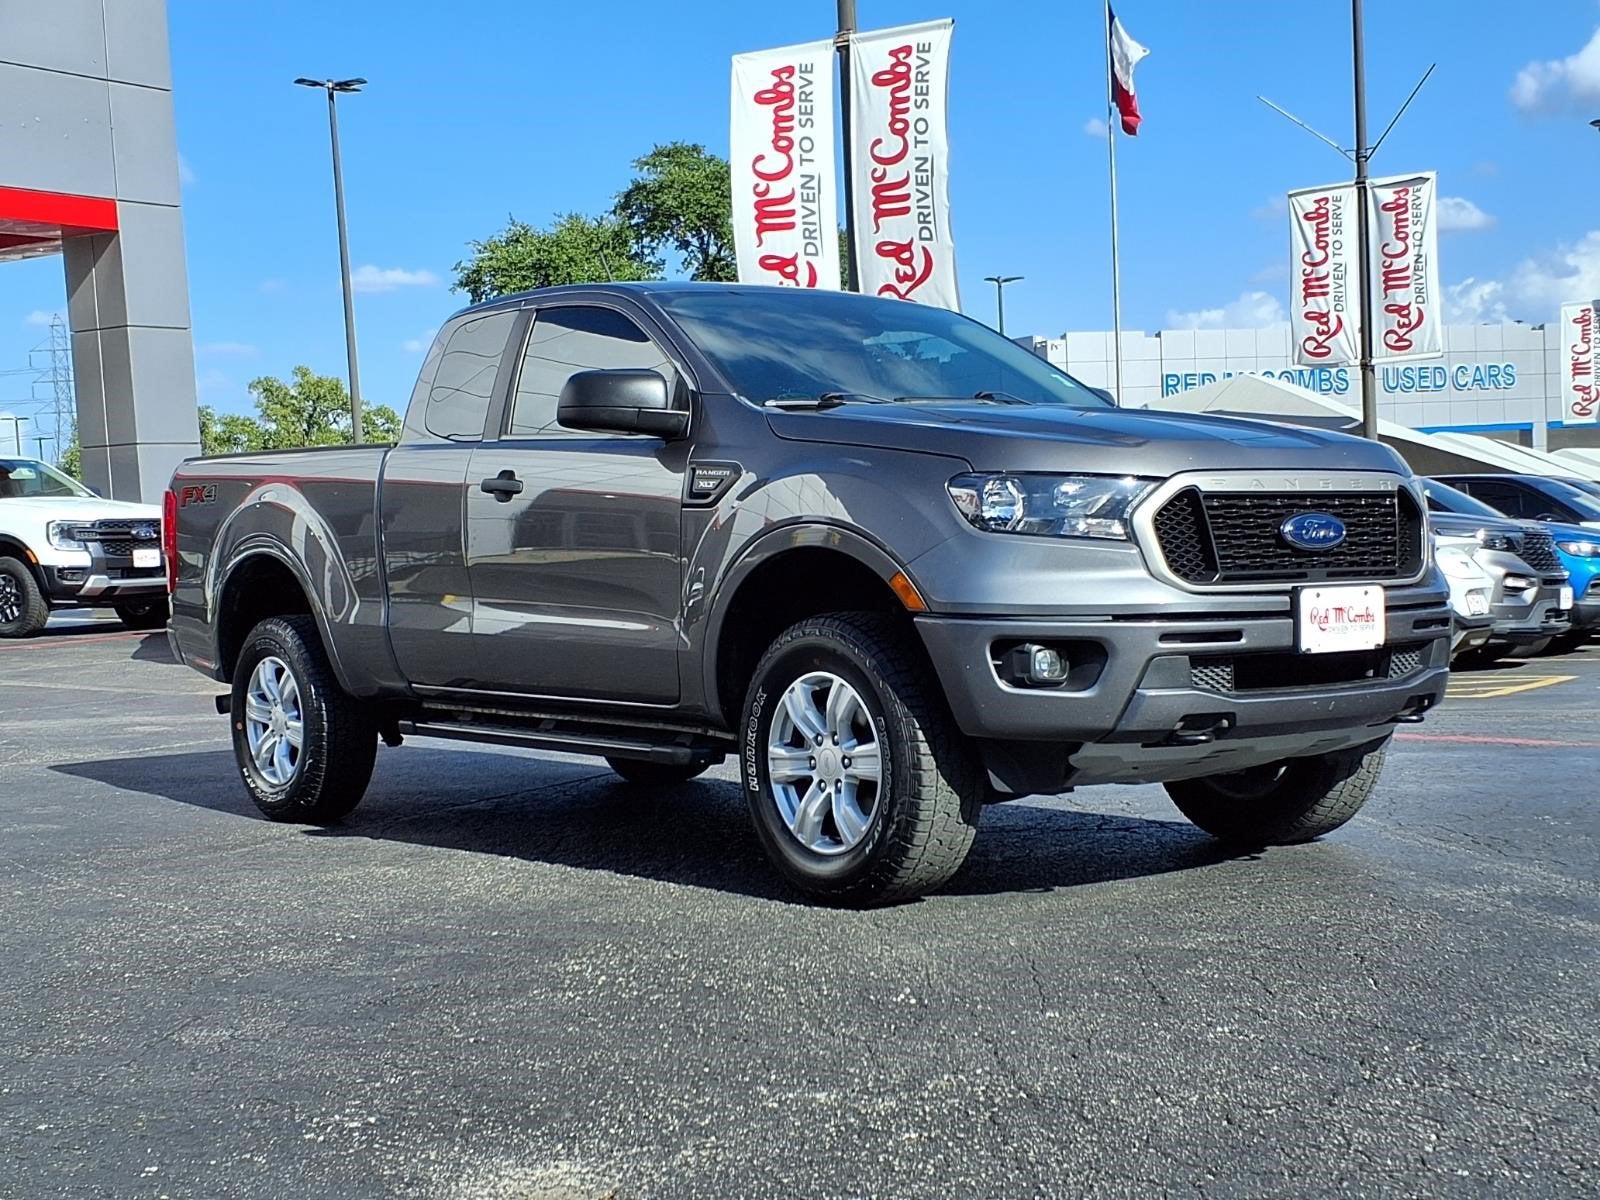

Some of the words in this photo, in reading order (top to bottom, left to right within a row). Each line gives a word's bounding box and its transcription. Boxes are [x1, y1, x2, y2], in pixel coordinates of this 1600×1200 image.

[915, 42, 931, 109] SERVE
[799, 62, 814, 129] SERVE
[799, 136, 815, 167] TO
[914, 117, 929, 149] TO
[801, 174, 818, 257] DRIVEN
[915, 156, 934, 242] DRIVEN
[1332, 195, 1342, 232] SERVE
[1412, 186, 1422, 226] SERVE
[1332, 235, 1343, 260] TO
[1412, 231, 1423, 251] TO
[1333, 263, 1344, 312] DRIVEN
[1414, 254, 1426, 305] DRIVEN
[1302, 310, 1343, 358] Red
[1384, 301, 1424, 352] Red
[1383, 366, 1447, 392] USED
[1453, 363, 1516, 391] CARS
[1571, 385, 1600, 416] Red
[180, 483, 218, 509] FX4
[1211, 478, 1391, 490] RANGER
[1310, 606, 1329, 631] Red
